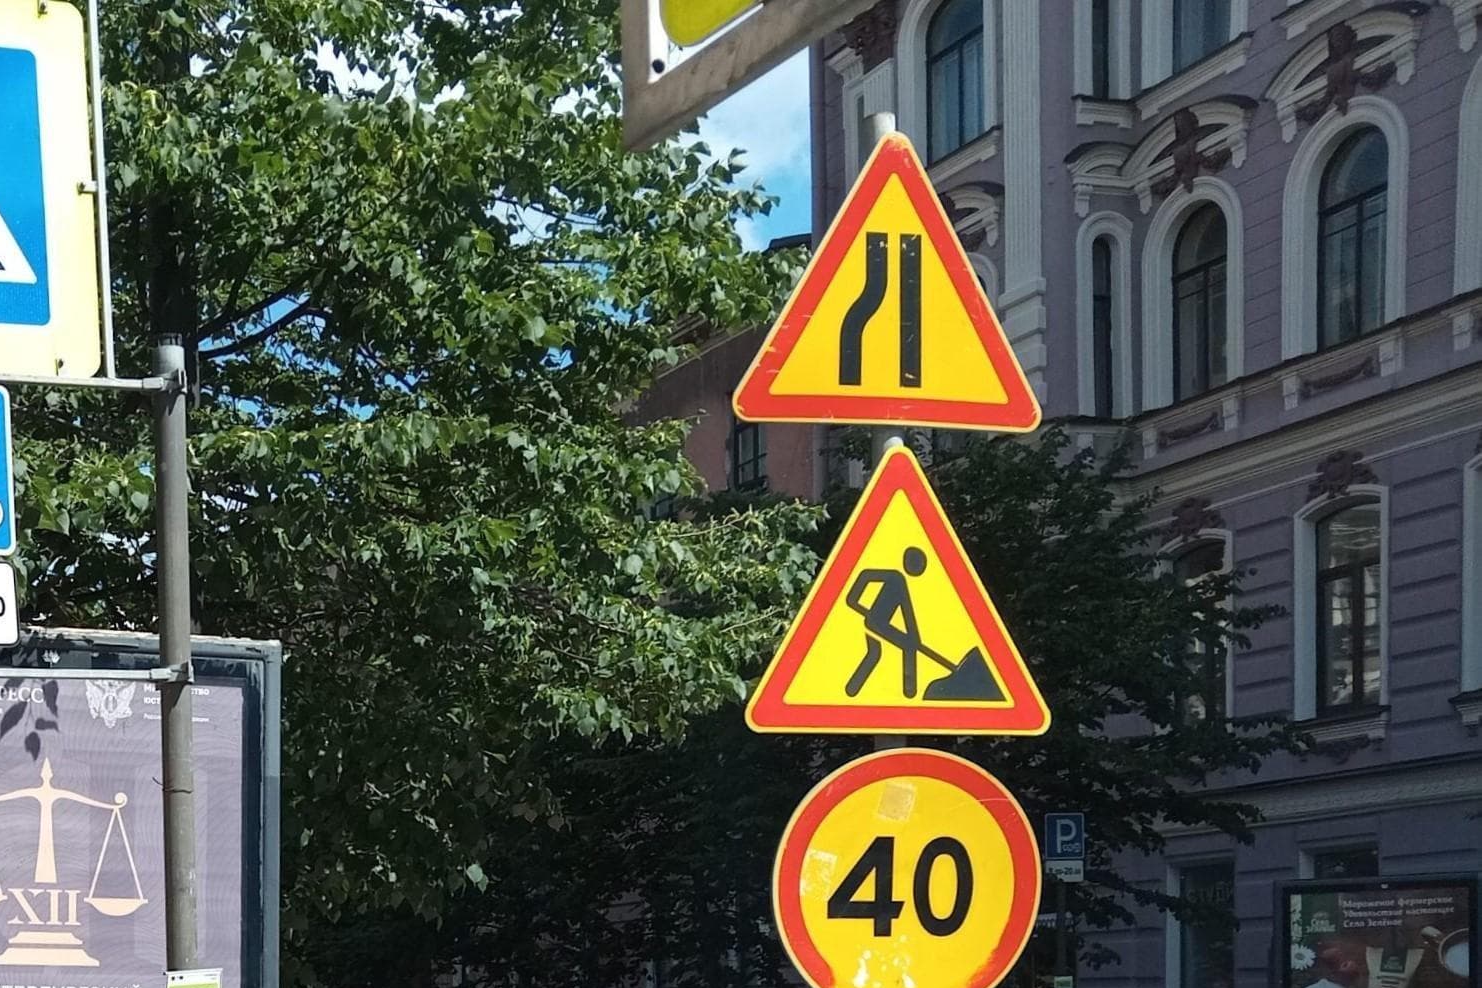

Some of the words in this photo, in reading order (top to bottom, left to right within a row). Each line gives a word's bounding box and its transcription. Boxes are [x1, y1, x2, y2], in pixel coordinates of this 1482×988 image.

[1056, 819, 1077, 853] P
[827, 836, 974, 937] 40
[7, 888, 81, 925] XII
